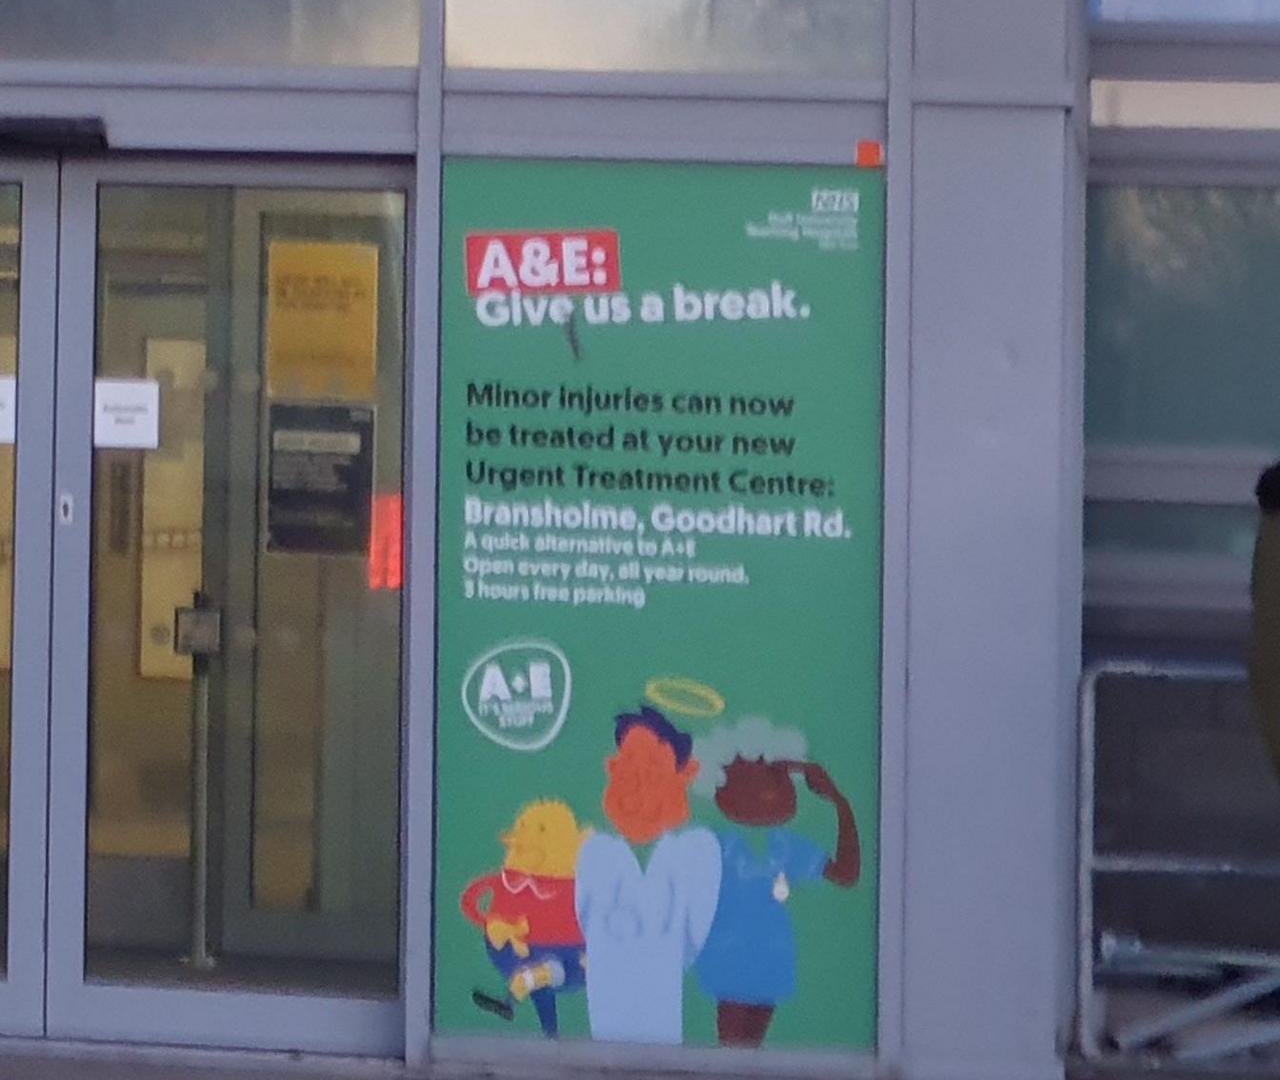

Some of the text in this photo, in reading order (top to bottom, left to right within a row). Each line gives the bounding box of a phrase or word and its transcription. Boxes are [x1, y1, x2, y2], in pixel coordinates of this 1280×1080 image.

[476, 238, 609, 288] A&E:
[475, 278, 810, 327] Give us a break.
[467, 382, 795, 417] Minor injuries can now
[466, 421, 796, 457] be treated at your new
[466, 460, 566, 491] Urgent
[573, 463, 721, 493] Treatment
[463, 496, 852, 539] Bransholme, Goodhart Rd.
[482, 532, 530, 554] quick
[534, 534, 634, 554] alternative
[637, 536, 658, 556] to
[463, 558, 516, 580] Open
[518, 561, 570, 582] every
[619, 562, 640, 581] all
[644, 567, 685, 585] year
[573, 583, 646, 609] parking
